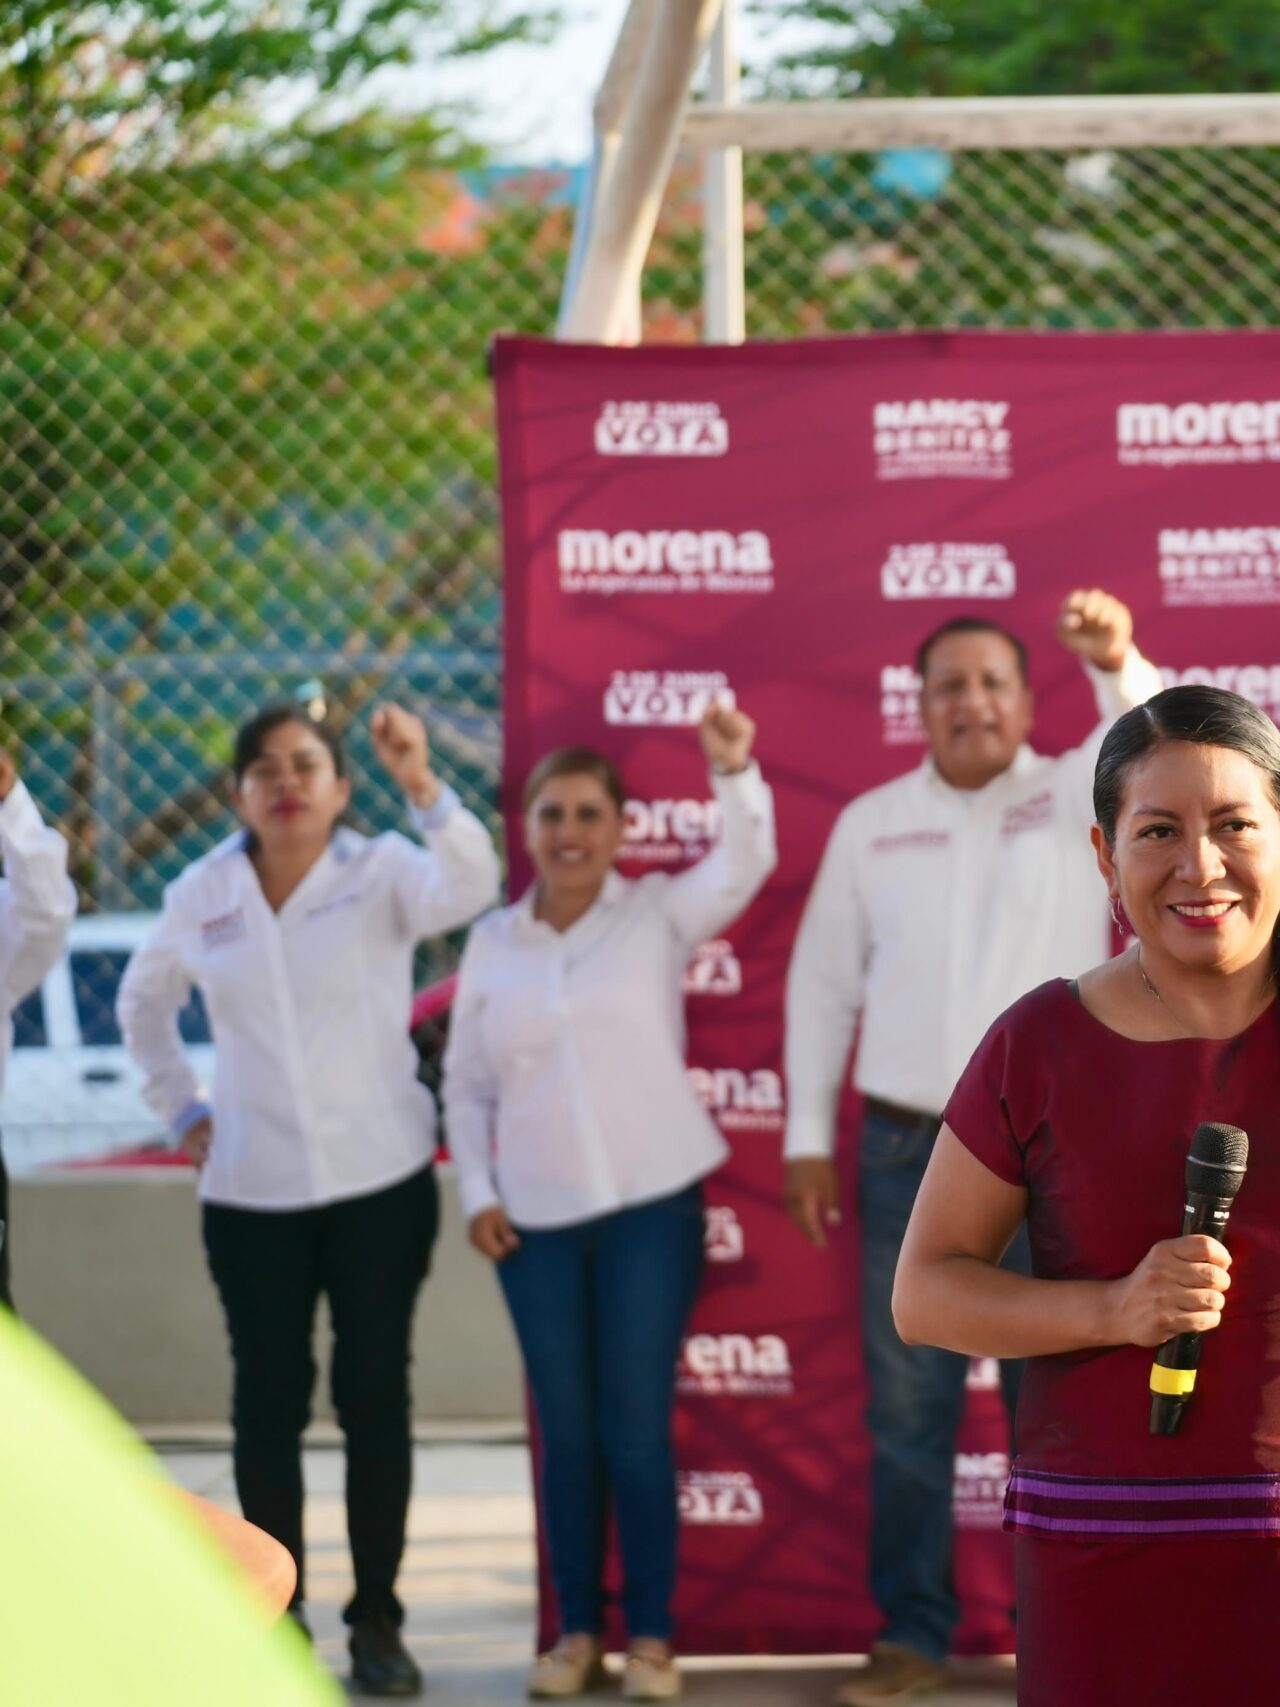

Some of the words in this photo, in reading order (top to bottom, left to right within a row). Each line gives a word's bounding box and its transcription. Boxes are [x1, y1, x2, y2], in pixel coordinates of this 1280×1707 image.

[874, 400, 1010, 427] NANCY
[599, 419, 723, 450] VOTA
[558, 529, 773, 573] morena
[885, 561, 1011, 593] VOTA
